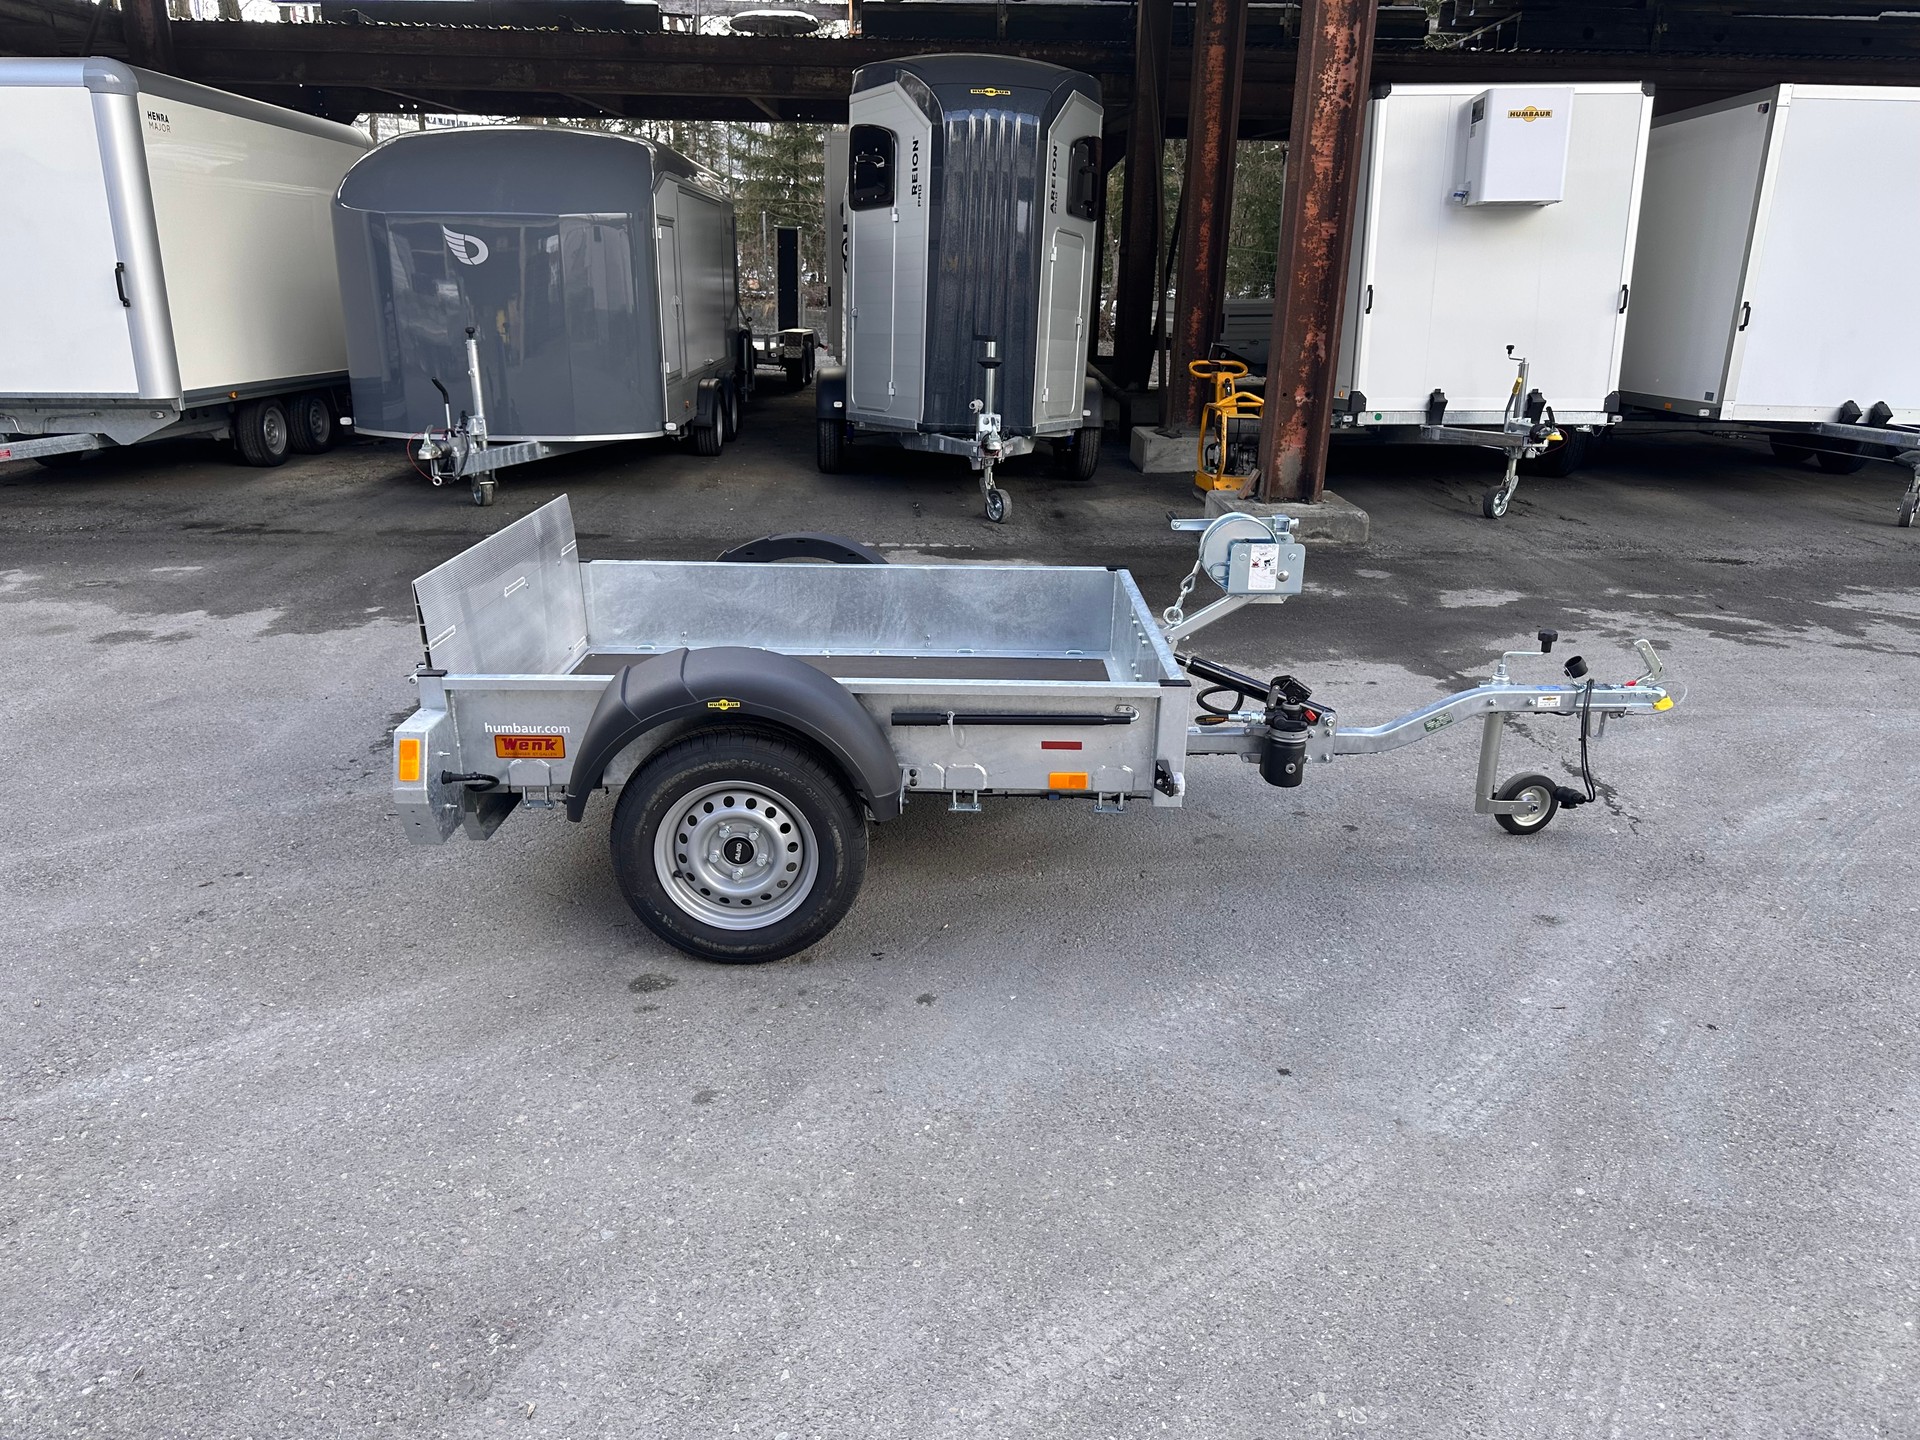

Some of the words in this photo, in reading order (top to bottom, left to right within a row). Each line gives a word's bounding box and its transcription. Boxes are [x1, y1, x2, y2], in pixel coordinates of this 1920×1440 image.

[147, 111, 169, 123] HENRA
[149, 121, 171, 133] MAJOR
[484, 722, 570, 733] humbaur.com
[501, 738, 557, 750] Wenk
